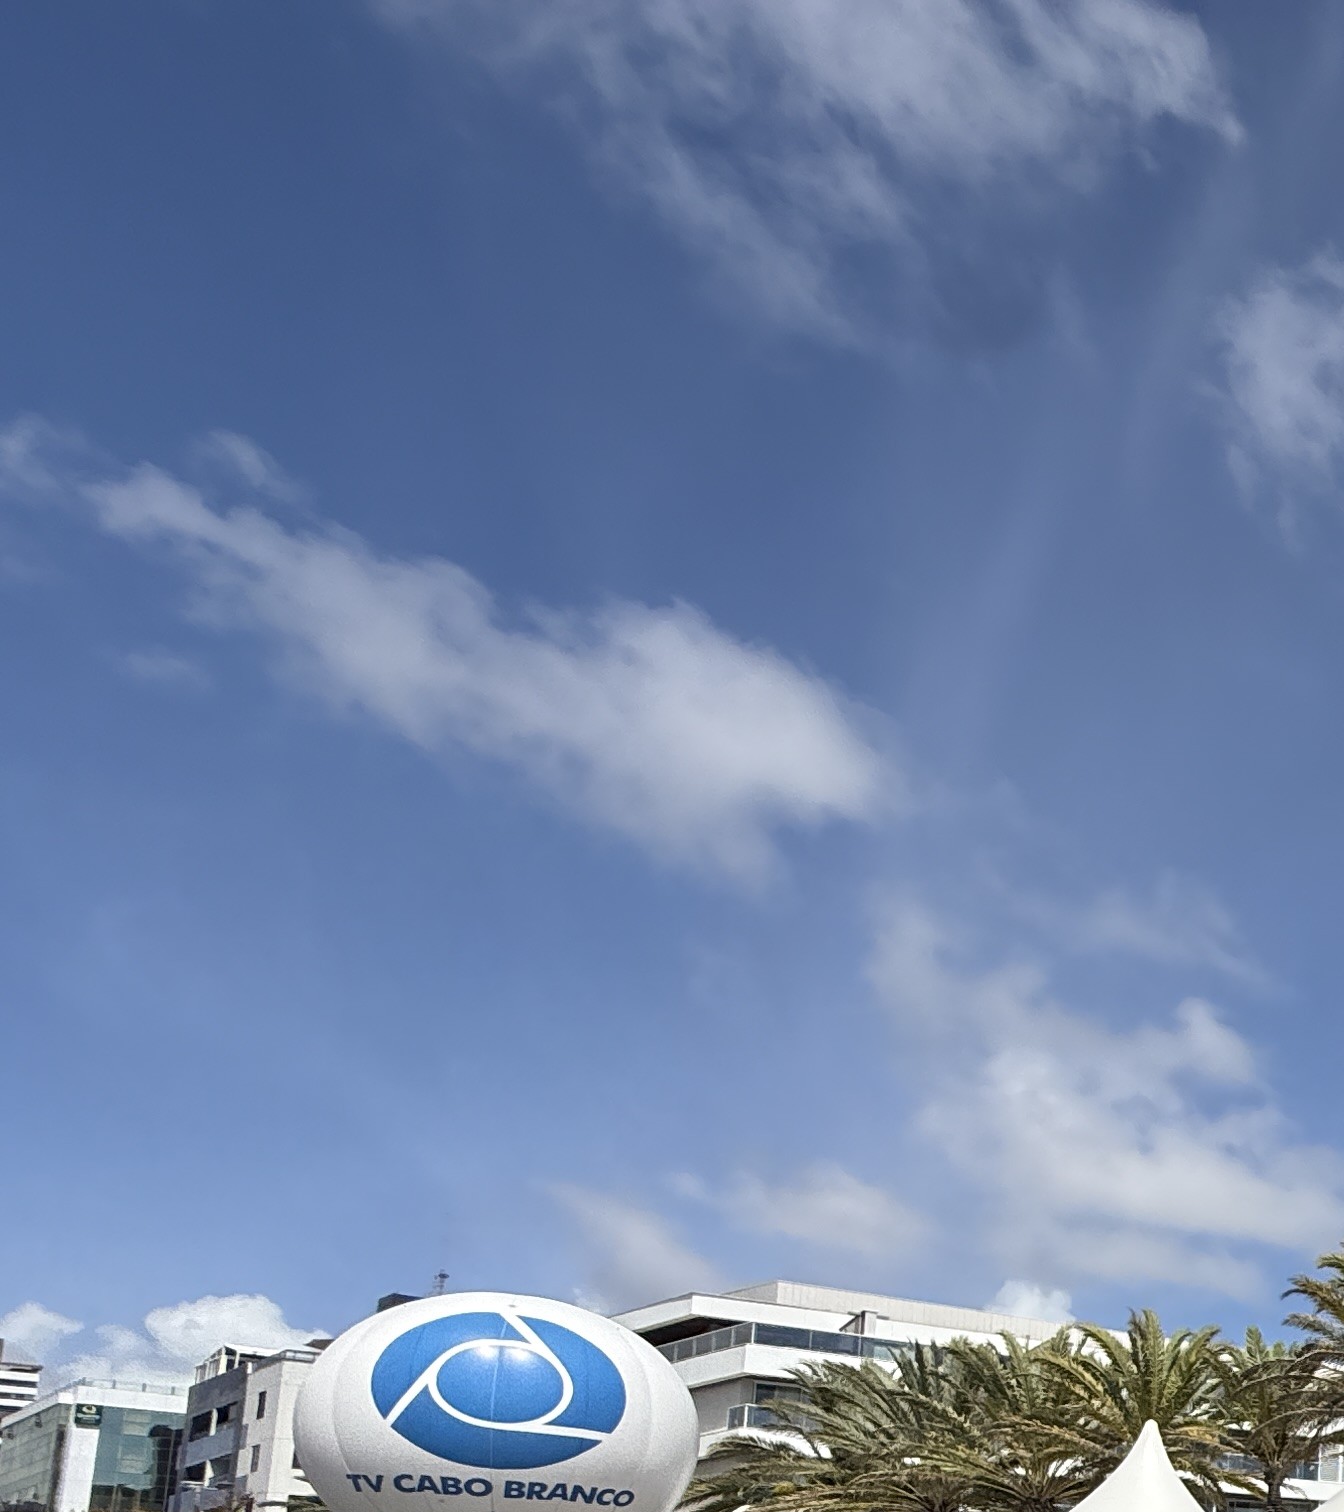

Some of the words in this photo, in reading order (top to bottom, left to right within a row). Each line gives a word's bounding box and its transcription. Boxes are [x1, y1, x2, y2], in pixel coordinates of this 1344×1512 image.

[346, 1473, 384, 1493] TV
[393, 1473, 493, 1498] CABO
[503, 1479, 636, 1507] BRANCO
